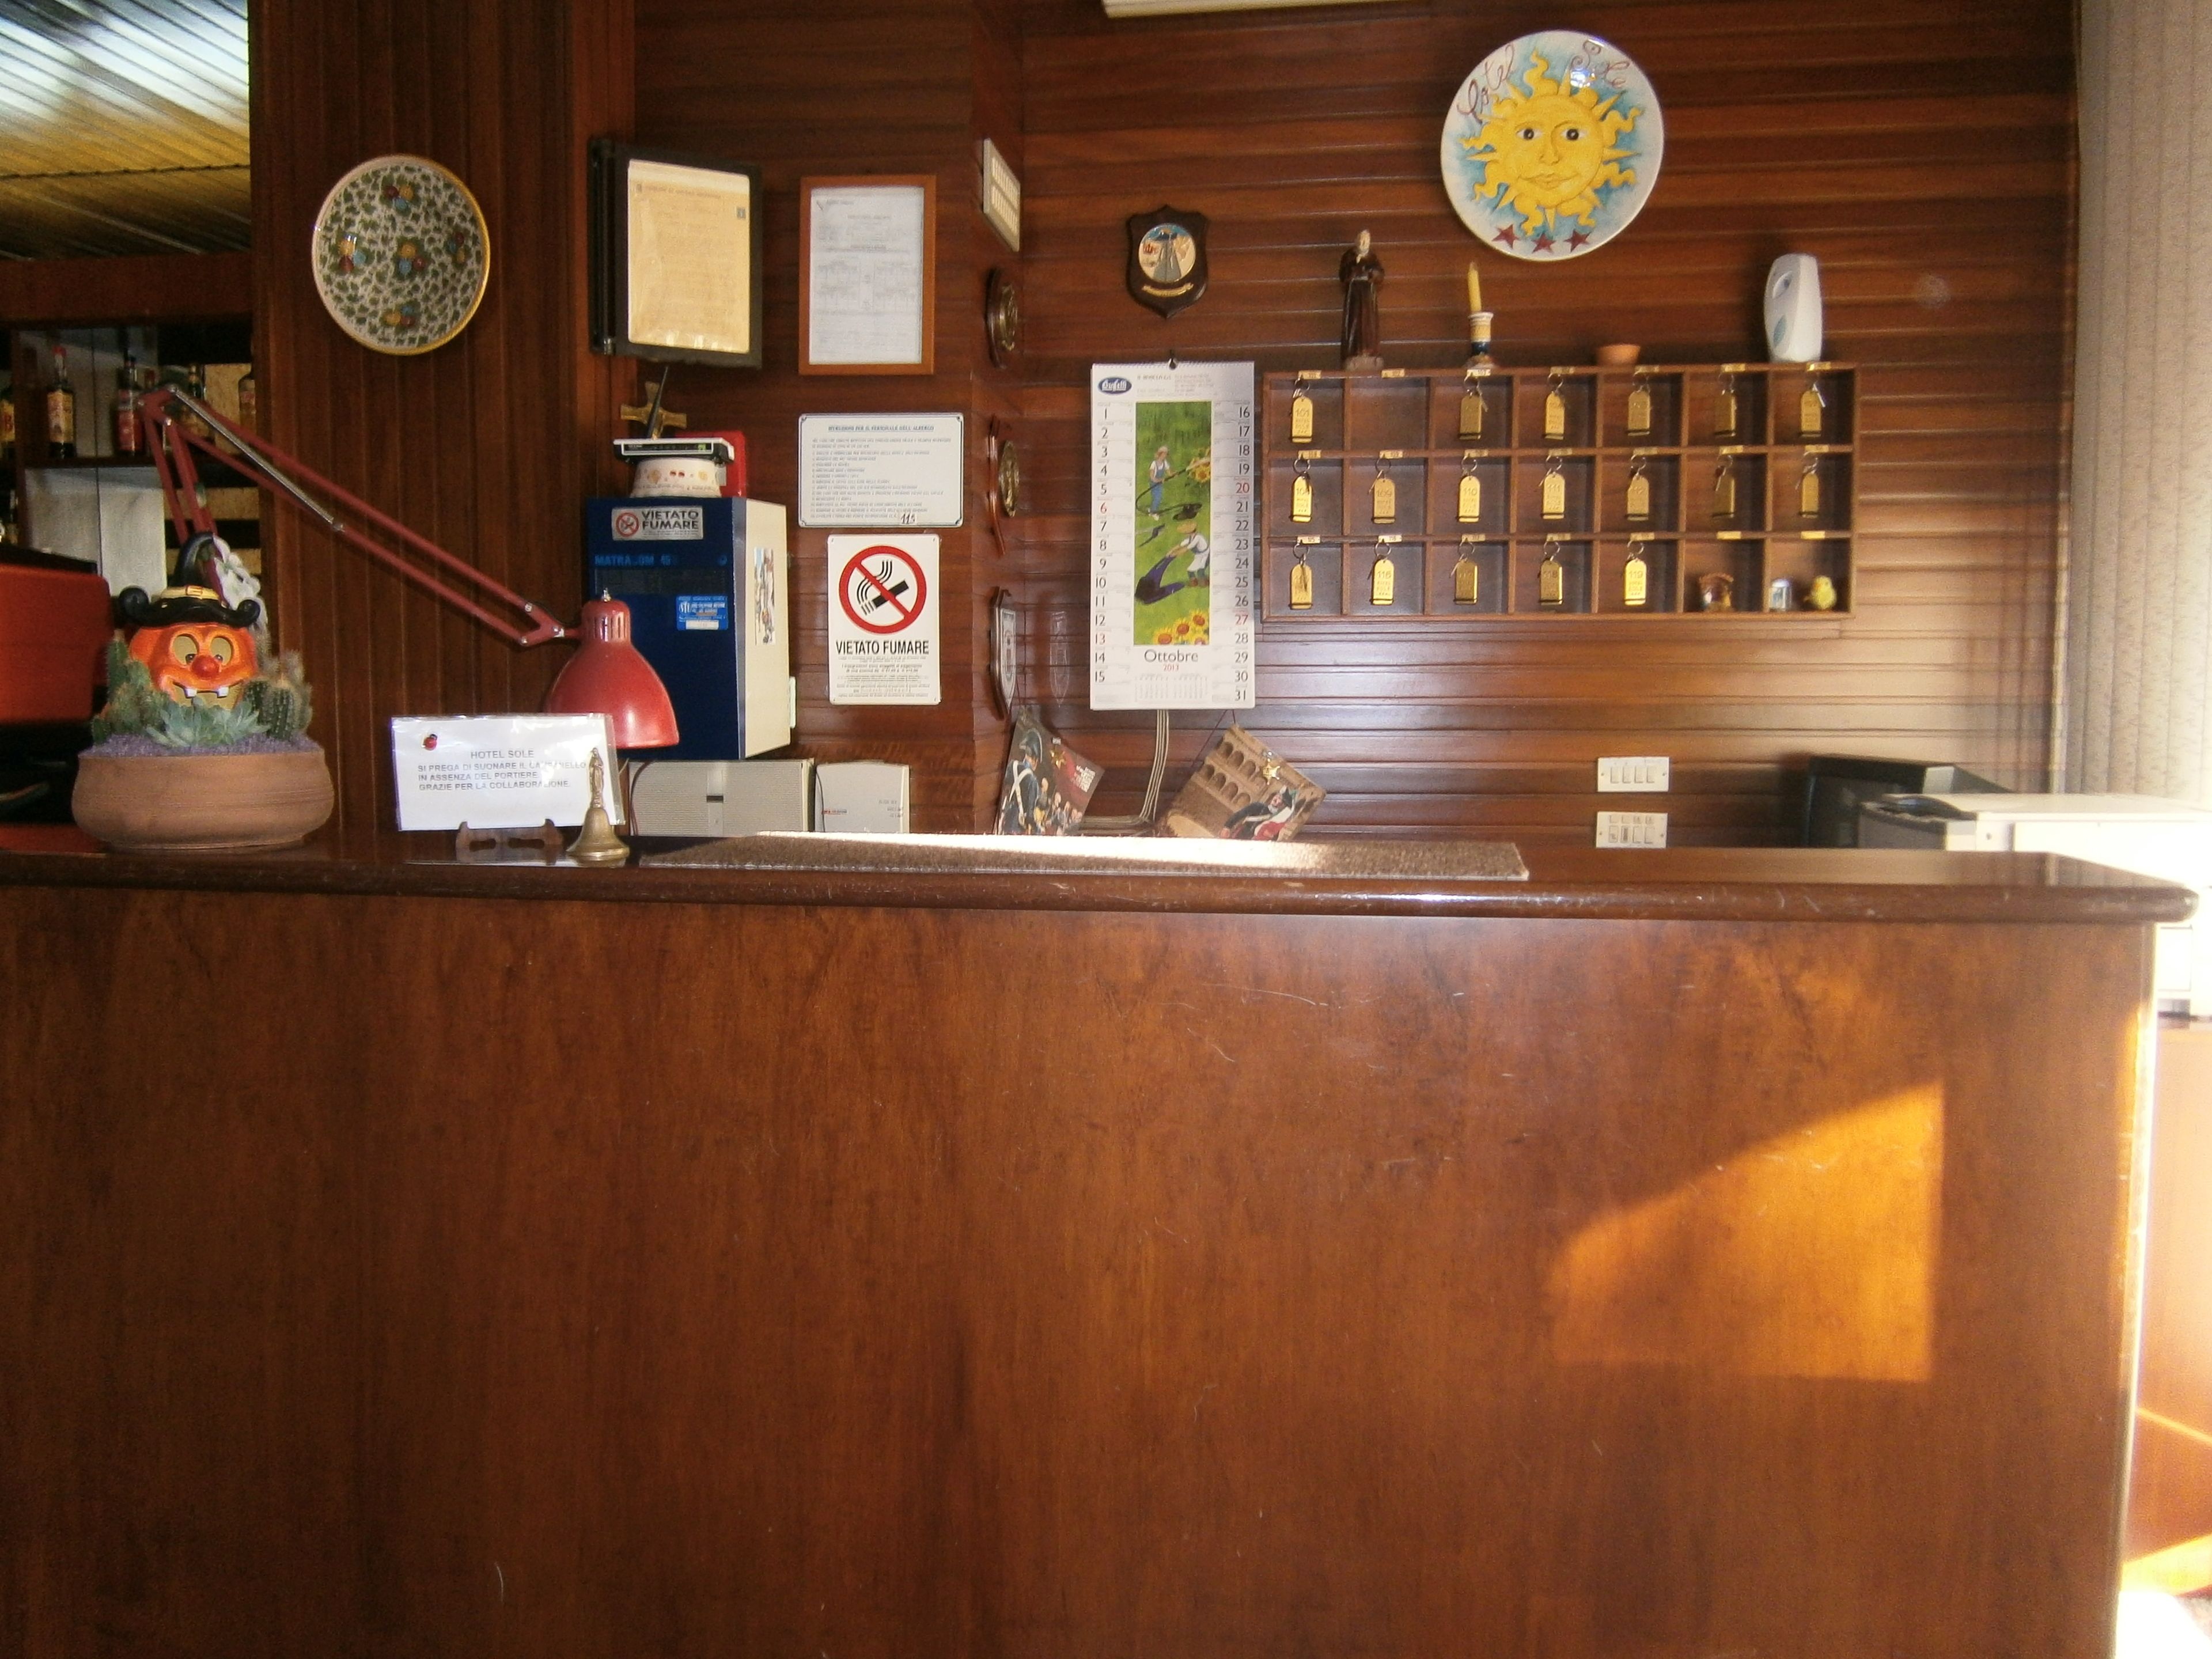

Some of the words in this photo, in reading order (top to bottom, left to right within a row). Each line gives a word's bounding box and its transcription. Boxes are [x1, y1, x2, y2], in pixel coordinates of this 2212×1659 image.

[1104, 408, 1107, 420] 1
[1239, 406, 1250, 418] 16
[1101, 428, 1108, 440] 2
[1239, 425, 1250, 437] 17
[1101, 446, 1108, 458] 3
[1239, 444, 1250, 456] 18
[1100, 464, 1107, 476] 4
[1239, 463, 1250, 475] 19
[1100, 483, 1106, 495] 5
[1236, 482, 1250, 494] 20
[1100, 502, 1106, 513] 6
[1236, 501, 1248, 513] 21
[642, 510, 699, 519] VIETATO
[642, 520, 699, 529] FUMARE
[1101, 520, 1107, 532] 7
[1235, 520, 1249, 531] 22
[1100, 540, 1107, 551] 8
[1236, 538, 1249, 550] 23
[1099, 558, 1107, 569] 9
[1236, 557, 1249, 569] 24
[1096, 577, 1107, 589] 10
[1235, 575, 1248, 588] 25
[1095, 596, 1105, 607] 11
[1235, 595, 1249, 607] 26
[1095, 614, 1105, 626] 12
[1236, 614, 1249, 624] 27
[1095, 634, 1105, 645] 13
[1235, 633, 1248, 644] 28
[836, 640, 880, 654] VIETATO
[883, 640, 929, 654] FUMARE
[1095, 652, 1105, 664] 14
[1144, 649, 1199, 662] Ottobre
[1234, 652, 1248, 663] 29
[1095, 671, 1105, 683] 15
[1235, 671, 1248, 682] 30
[1235, 690, 1247, 701] 31
[471, 751, 505, 759] HOTEL
[508, 750, 534, 758] SOLE
[529, 761, 586, 769] CAPANELLO
